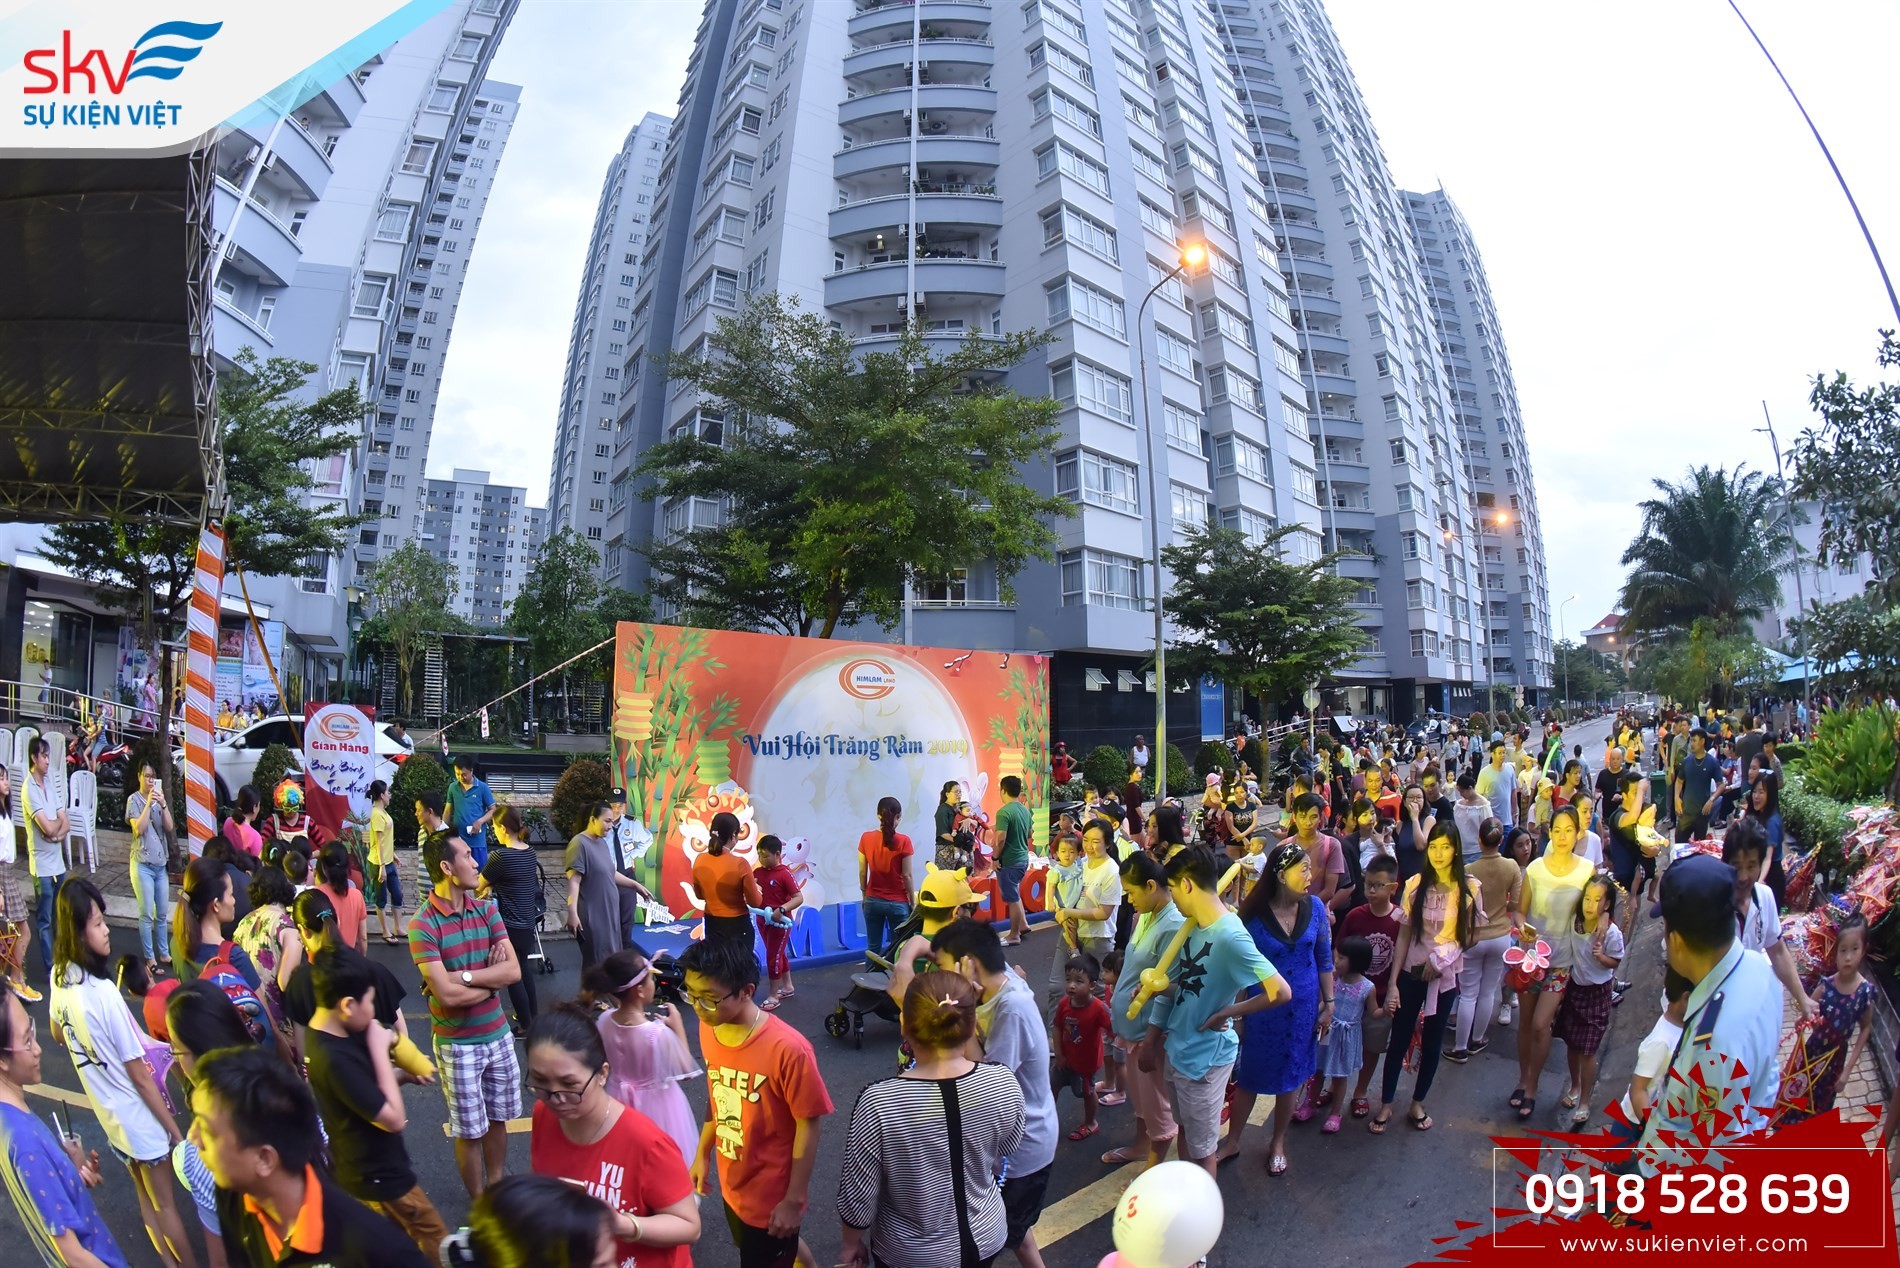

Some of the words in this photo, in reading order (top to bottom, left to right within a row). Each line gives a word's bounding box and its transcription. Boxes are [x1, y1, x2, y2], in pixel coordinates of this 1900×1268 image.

[856, 675, 882, 684] HIMLAM
[311, 740, 337, 751] Gian
[742, 734, 780, 756] Vui
[781, 730, 820, 760] Hội
[823, 734, 880, 760] Trăng
[883, 733, 923, 757] Rằm
[927, 738, 970, 758] 2019
[600, 1161, 625, 1188] YU
